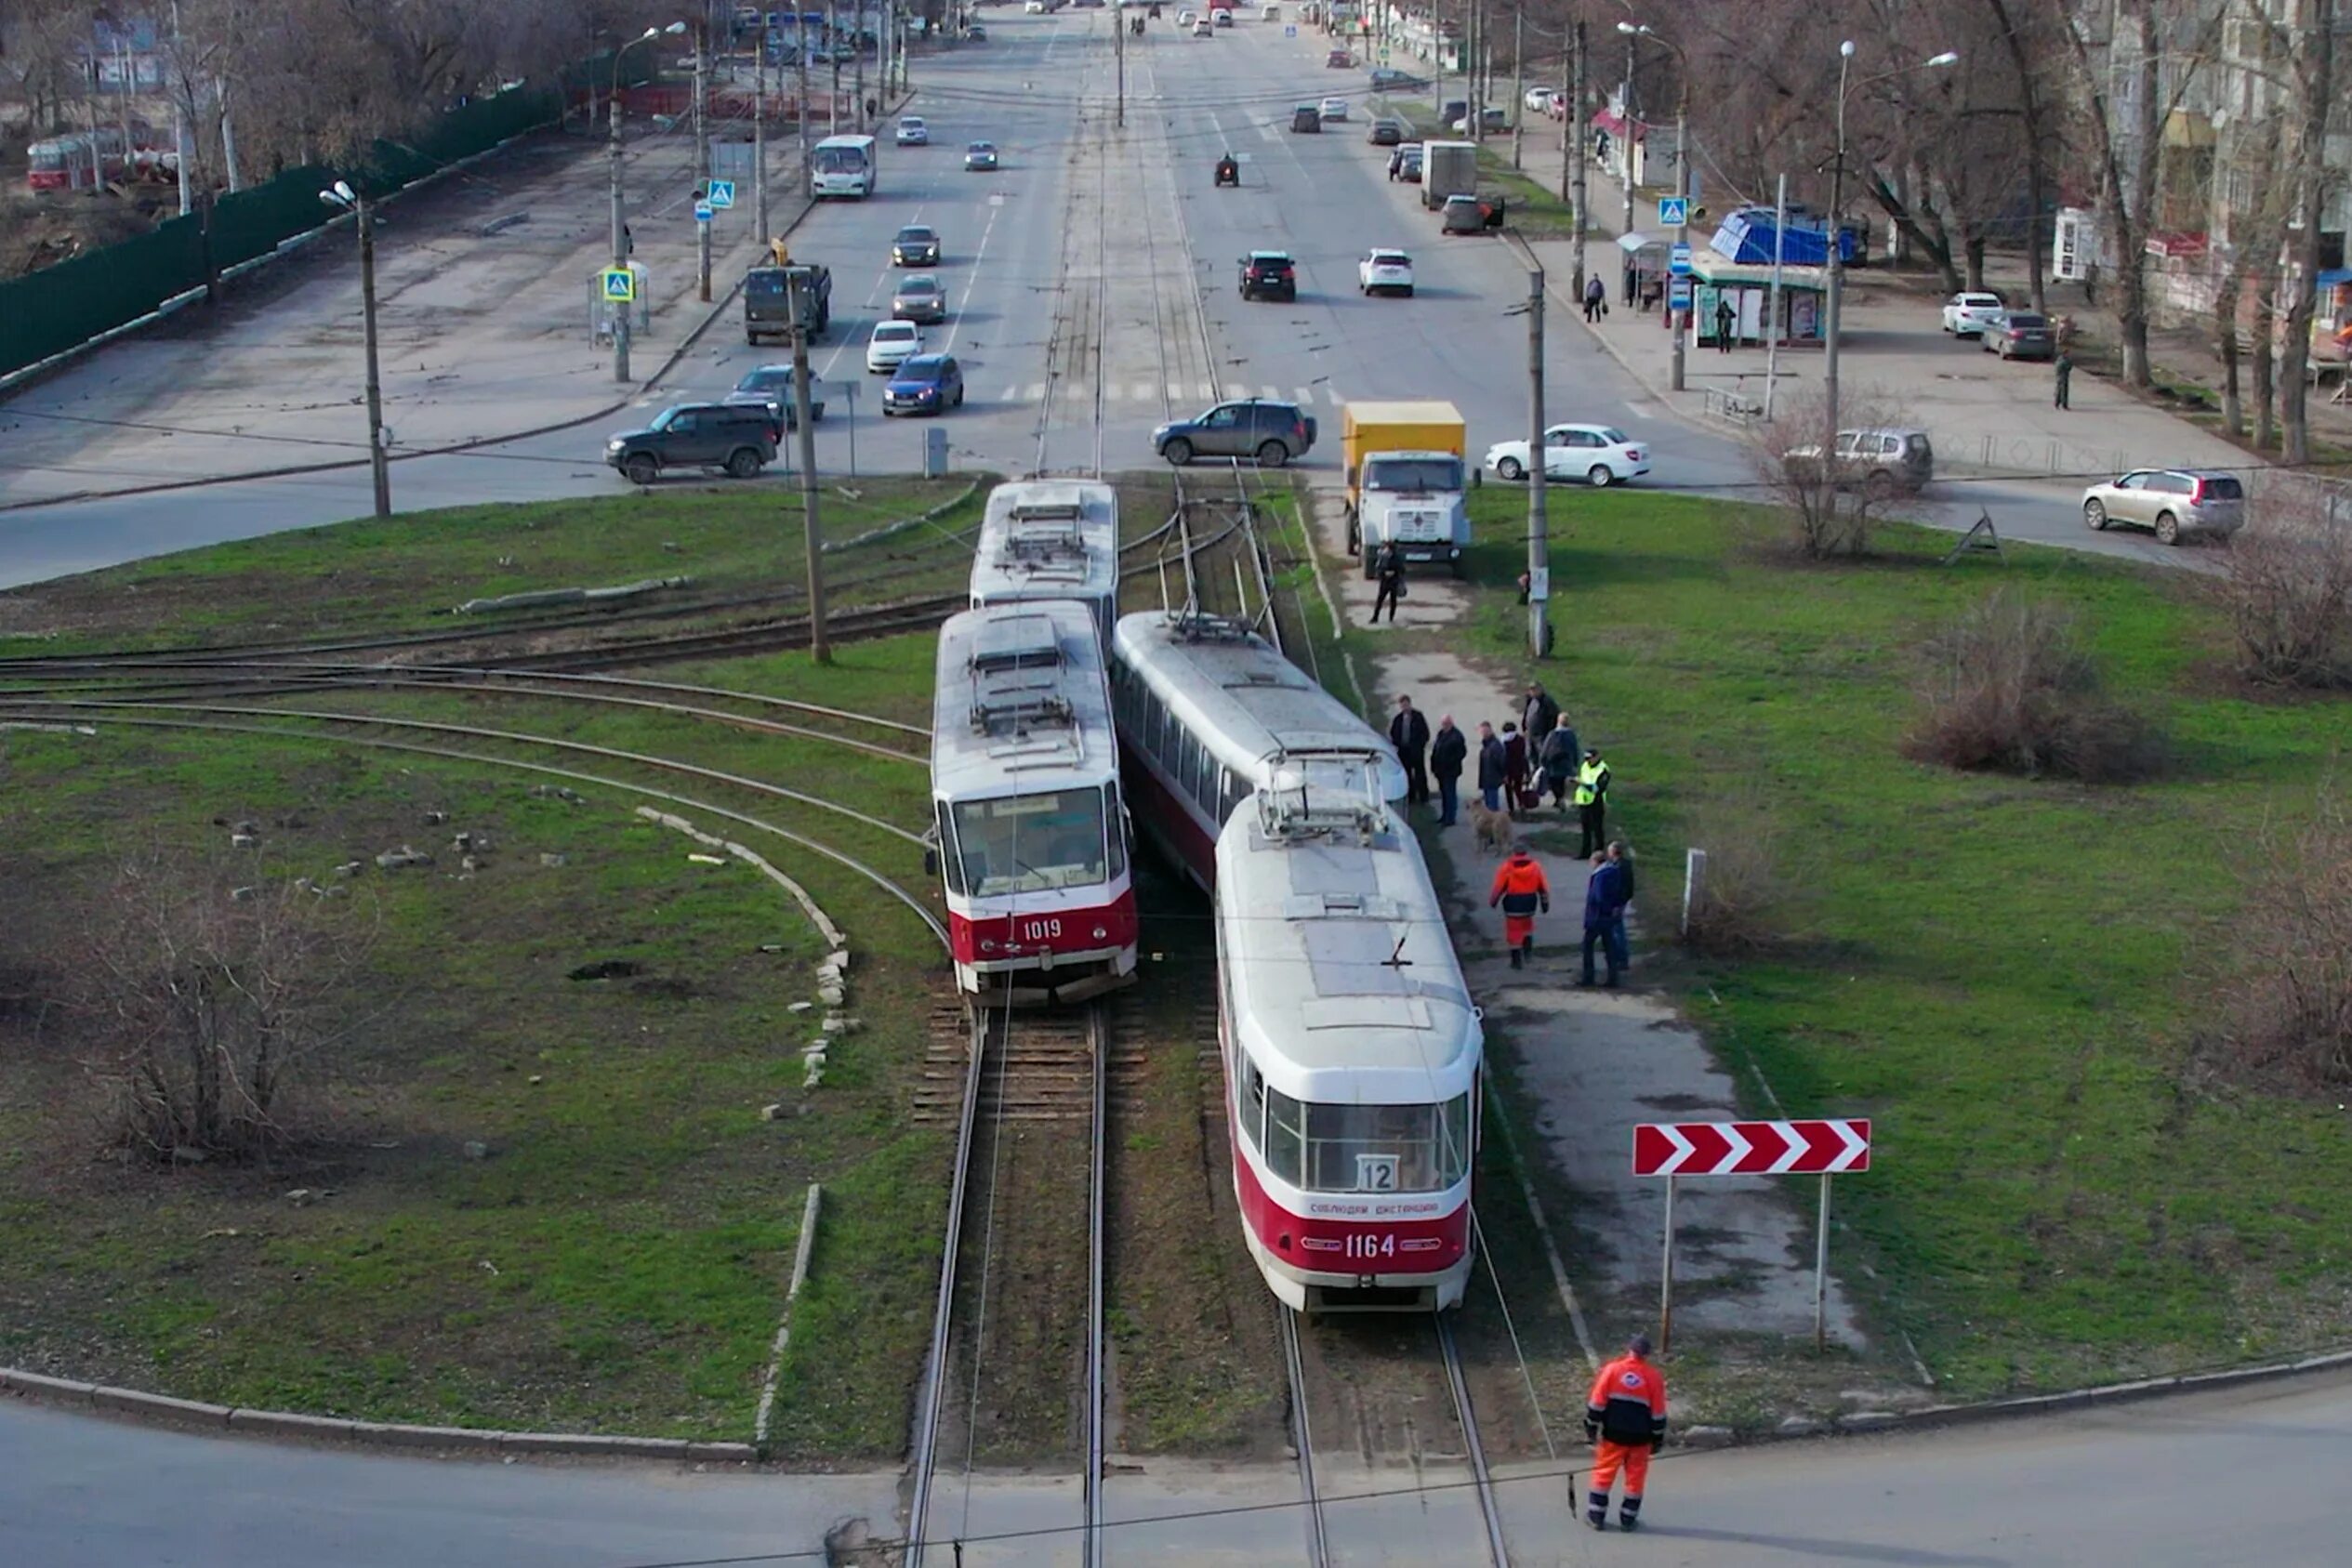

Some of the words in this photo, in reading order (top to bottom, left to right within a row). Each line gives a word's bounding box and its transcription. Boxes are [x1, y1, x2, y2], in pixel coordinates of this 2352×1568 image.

[1024, 918, 1062, 941] 1019
[1364, 1165, 1391, 1189] 12
[1346, 1233, 1394, 1258] 1164
